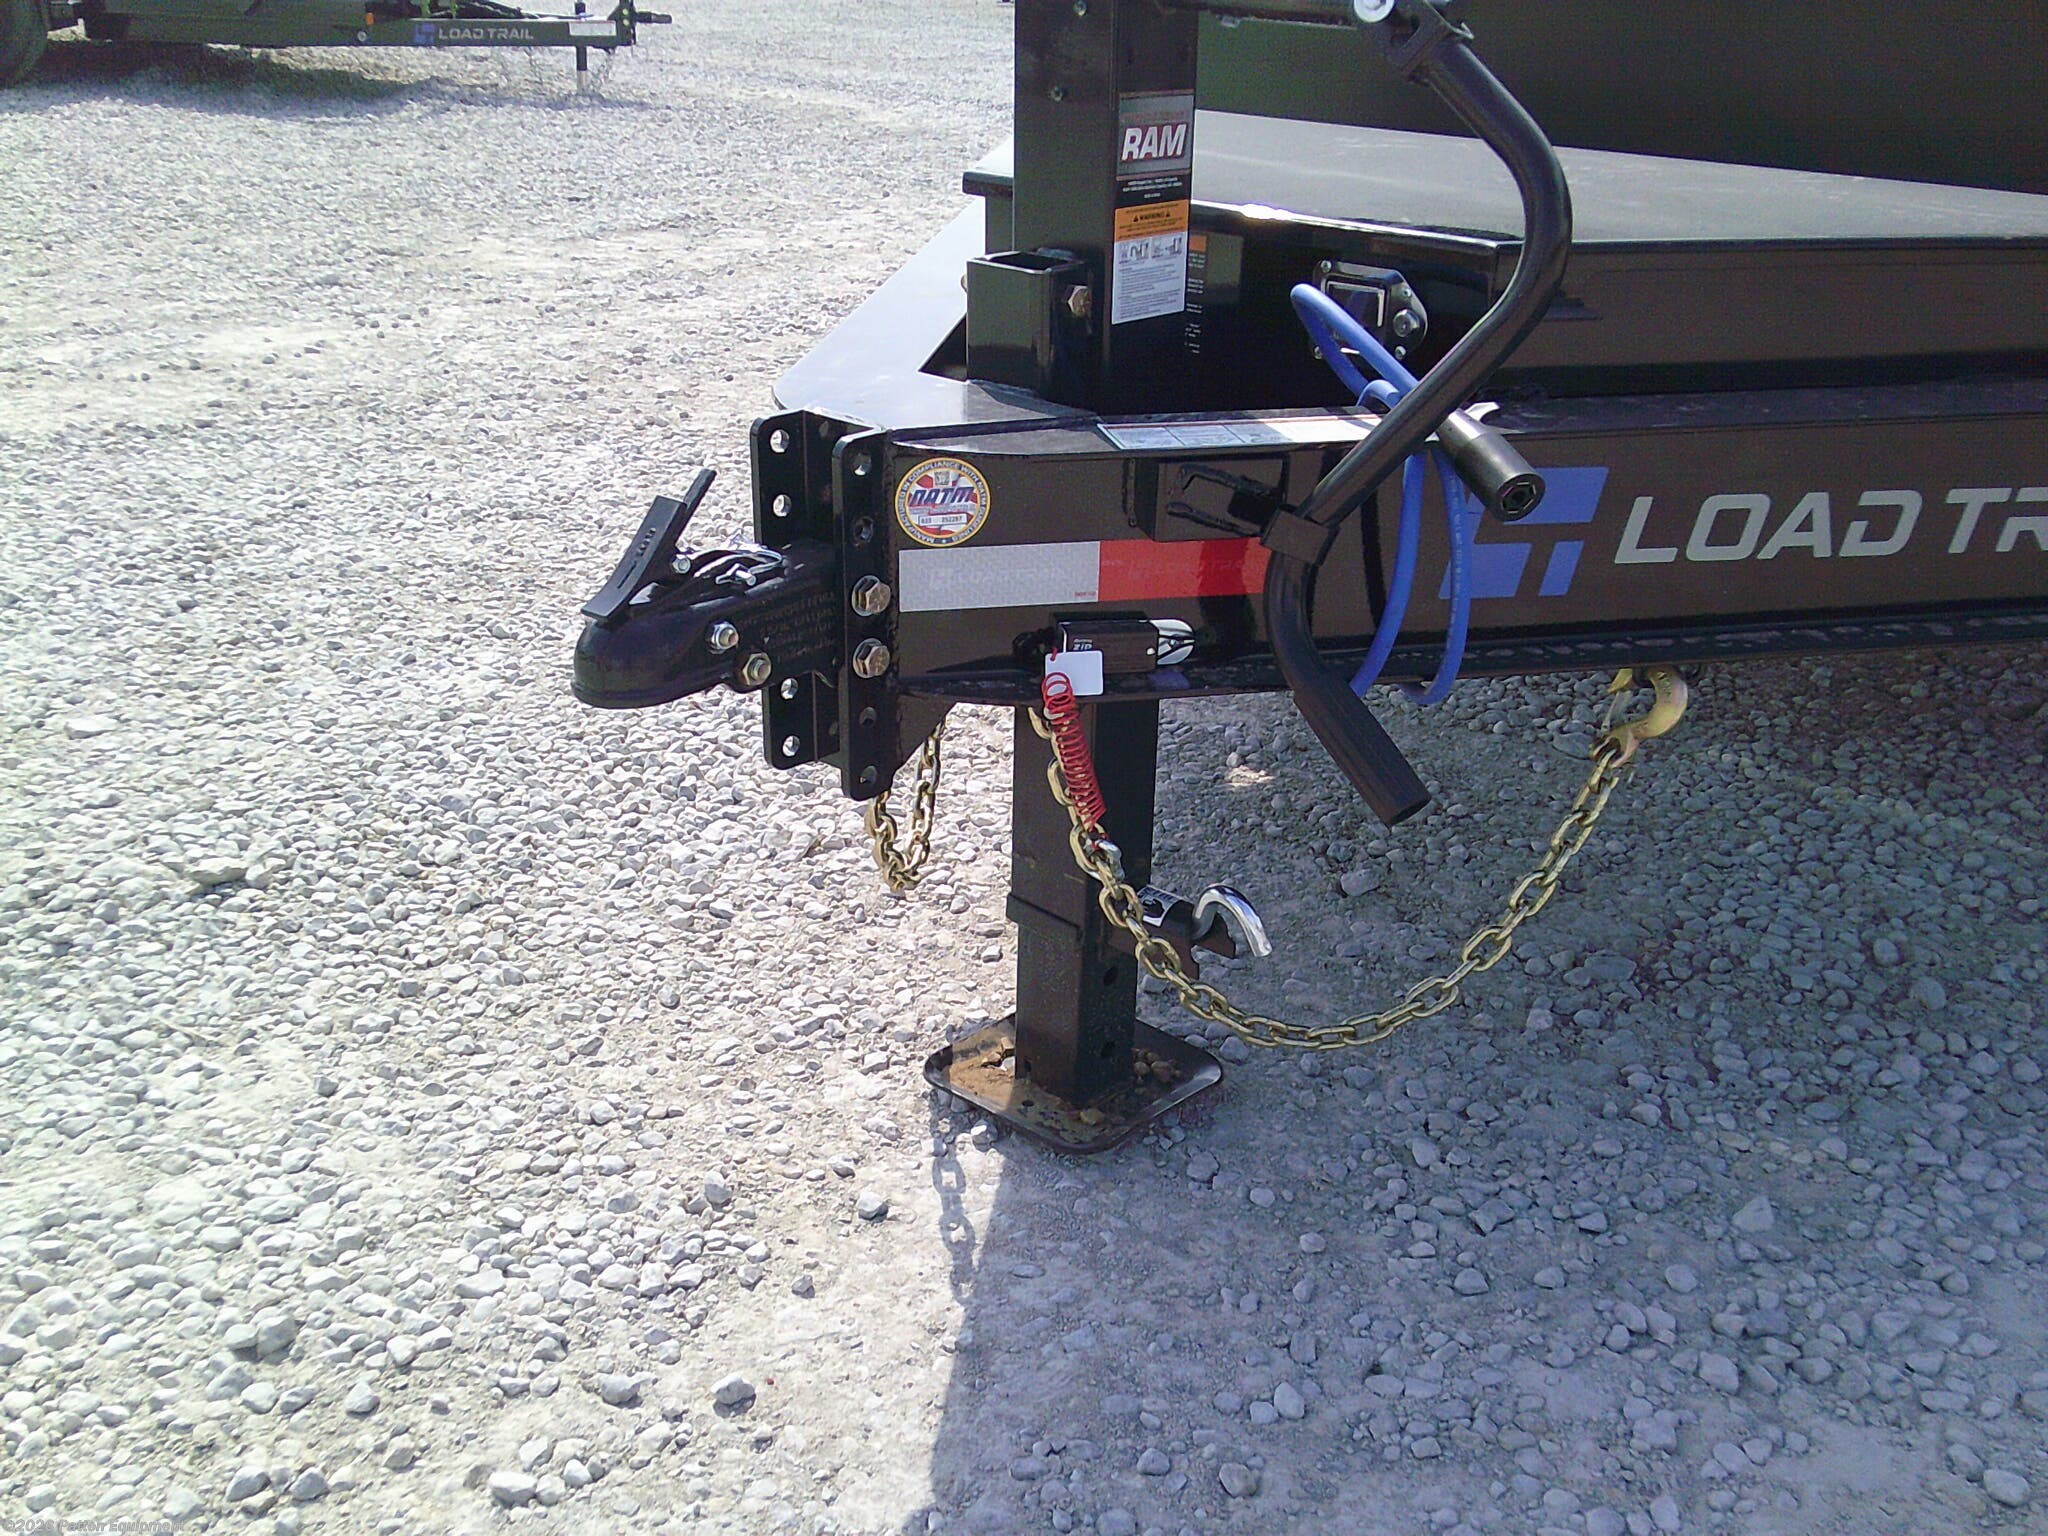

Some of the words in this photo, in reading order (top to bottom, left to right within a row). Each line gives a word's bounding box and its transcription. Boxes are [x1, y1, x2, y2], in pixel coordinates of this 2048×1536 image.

[438, 28, 485, 40] LOAD
[489, 28, 534, 40] TRAIL
[1121, 123, 1187, 161] RAM
[905, 460, 960, 483] COMPLIANCE
[959, 463, 982, 482] WITH
[909, 487, 975, 507] NATM
[1614, 490, 1923, 564] LOAD
